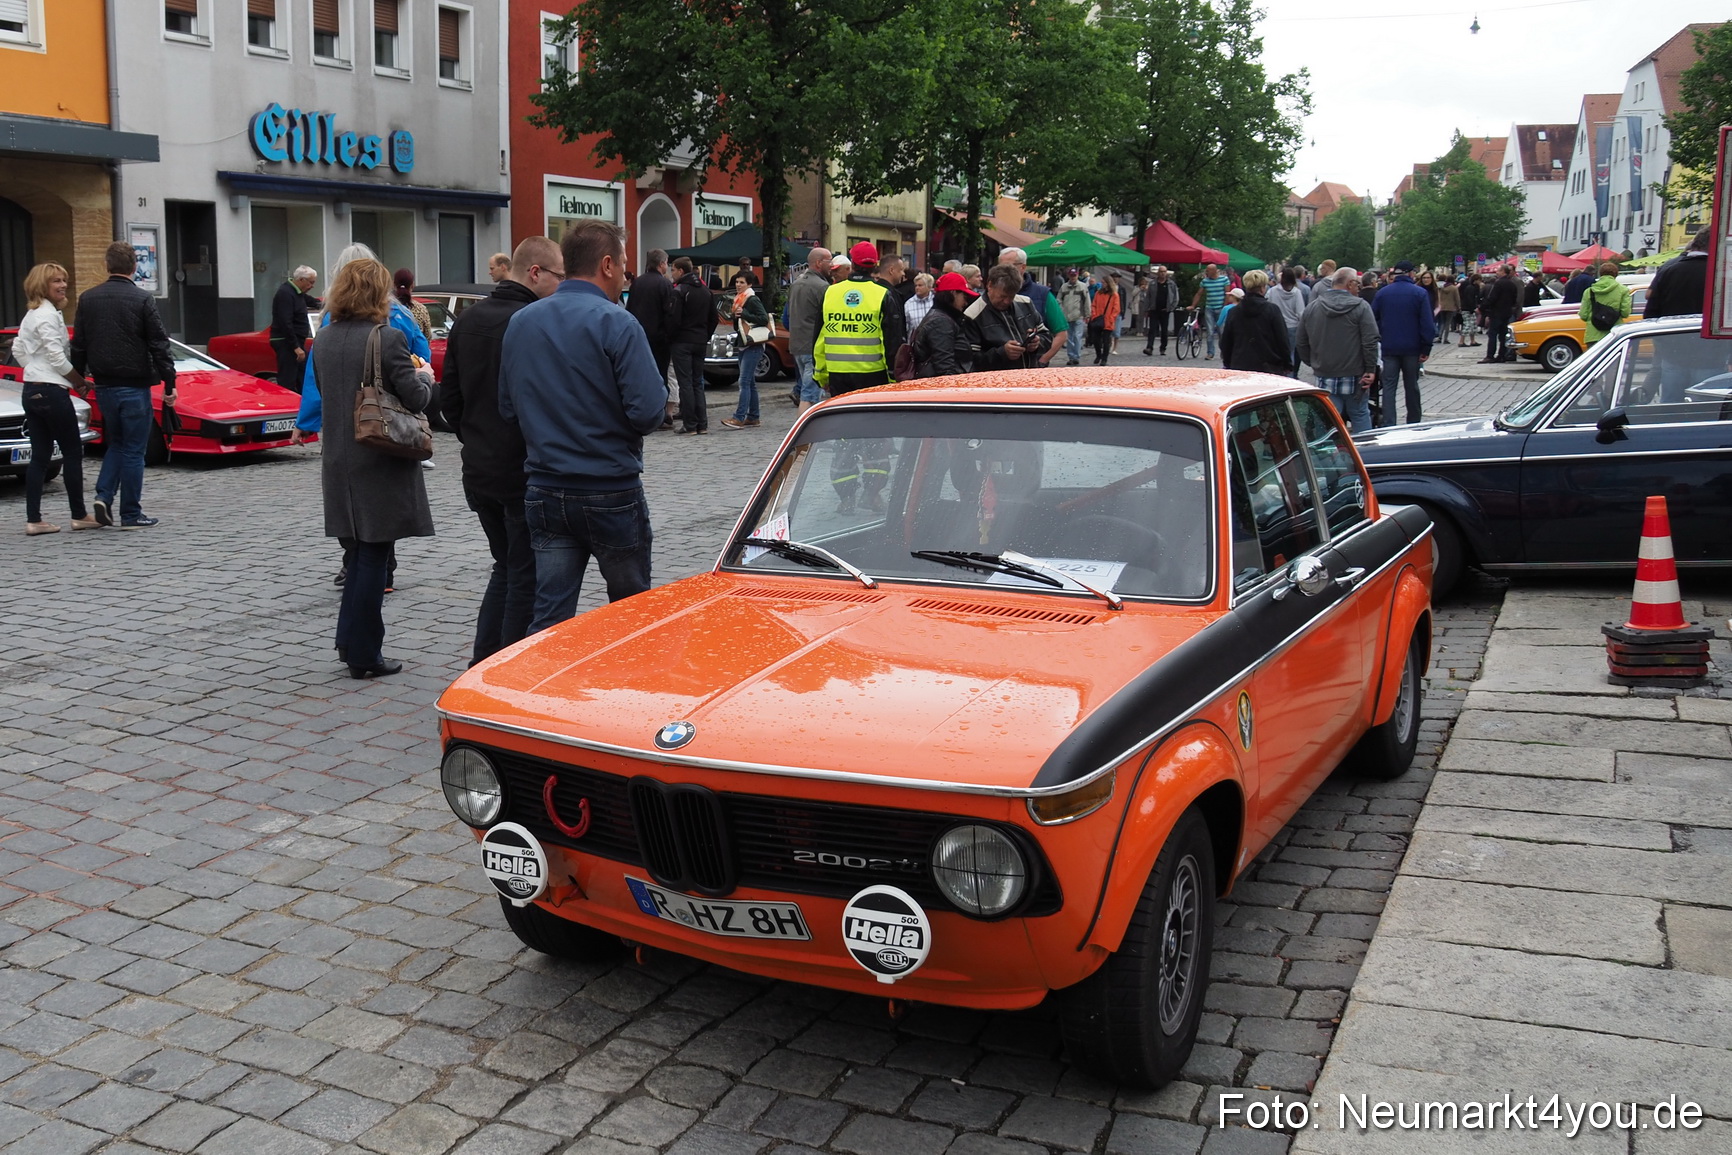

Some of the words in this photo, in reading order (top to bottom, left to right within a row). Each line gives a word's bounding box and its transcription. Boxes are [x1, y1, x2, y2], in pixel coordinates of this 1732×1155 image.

[248, 101, 382, 170] Eilles
[138, 197, 147, 207] 31
[828, 313, 873, 322] FOLLOW
[841, 324, 858, 332] ME
[1057, 563, 1097, 573] 225
[487, 852, 537, 876] Hella
[510, 881, 532, 892] HELLA
[647, 888, 676, 918] R
[687, 901, 745, 932] HZ
[748, 907, 804, 936] 8H
[901, 916, 919, 925] 500
[849, 918, 919, 948] Hella
[878, 953, 909, 965] HELLA
